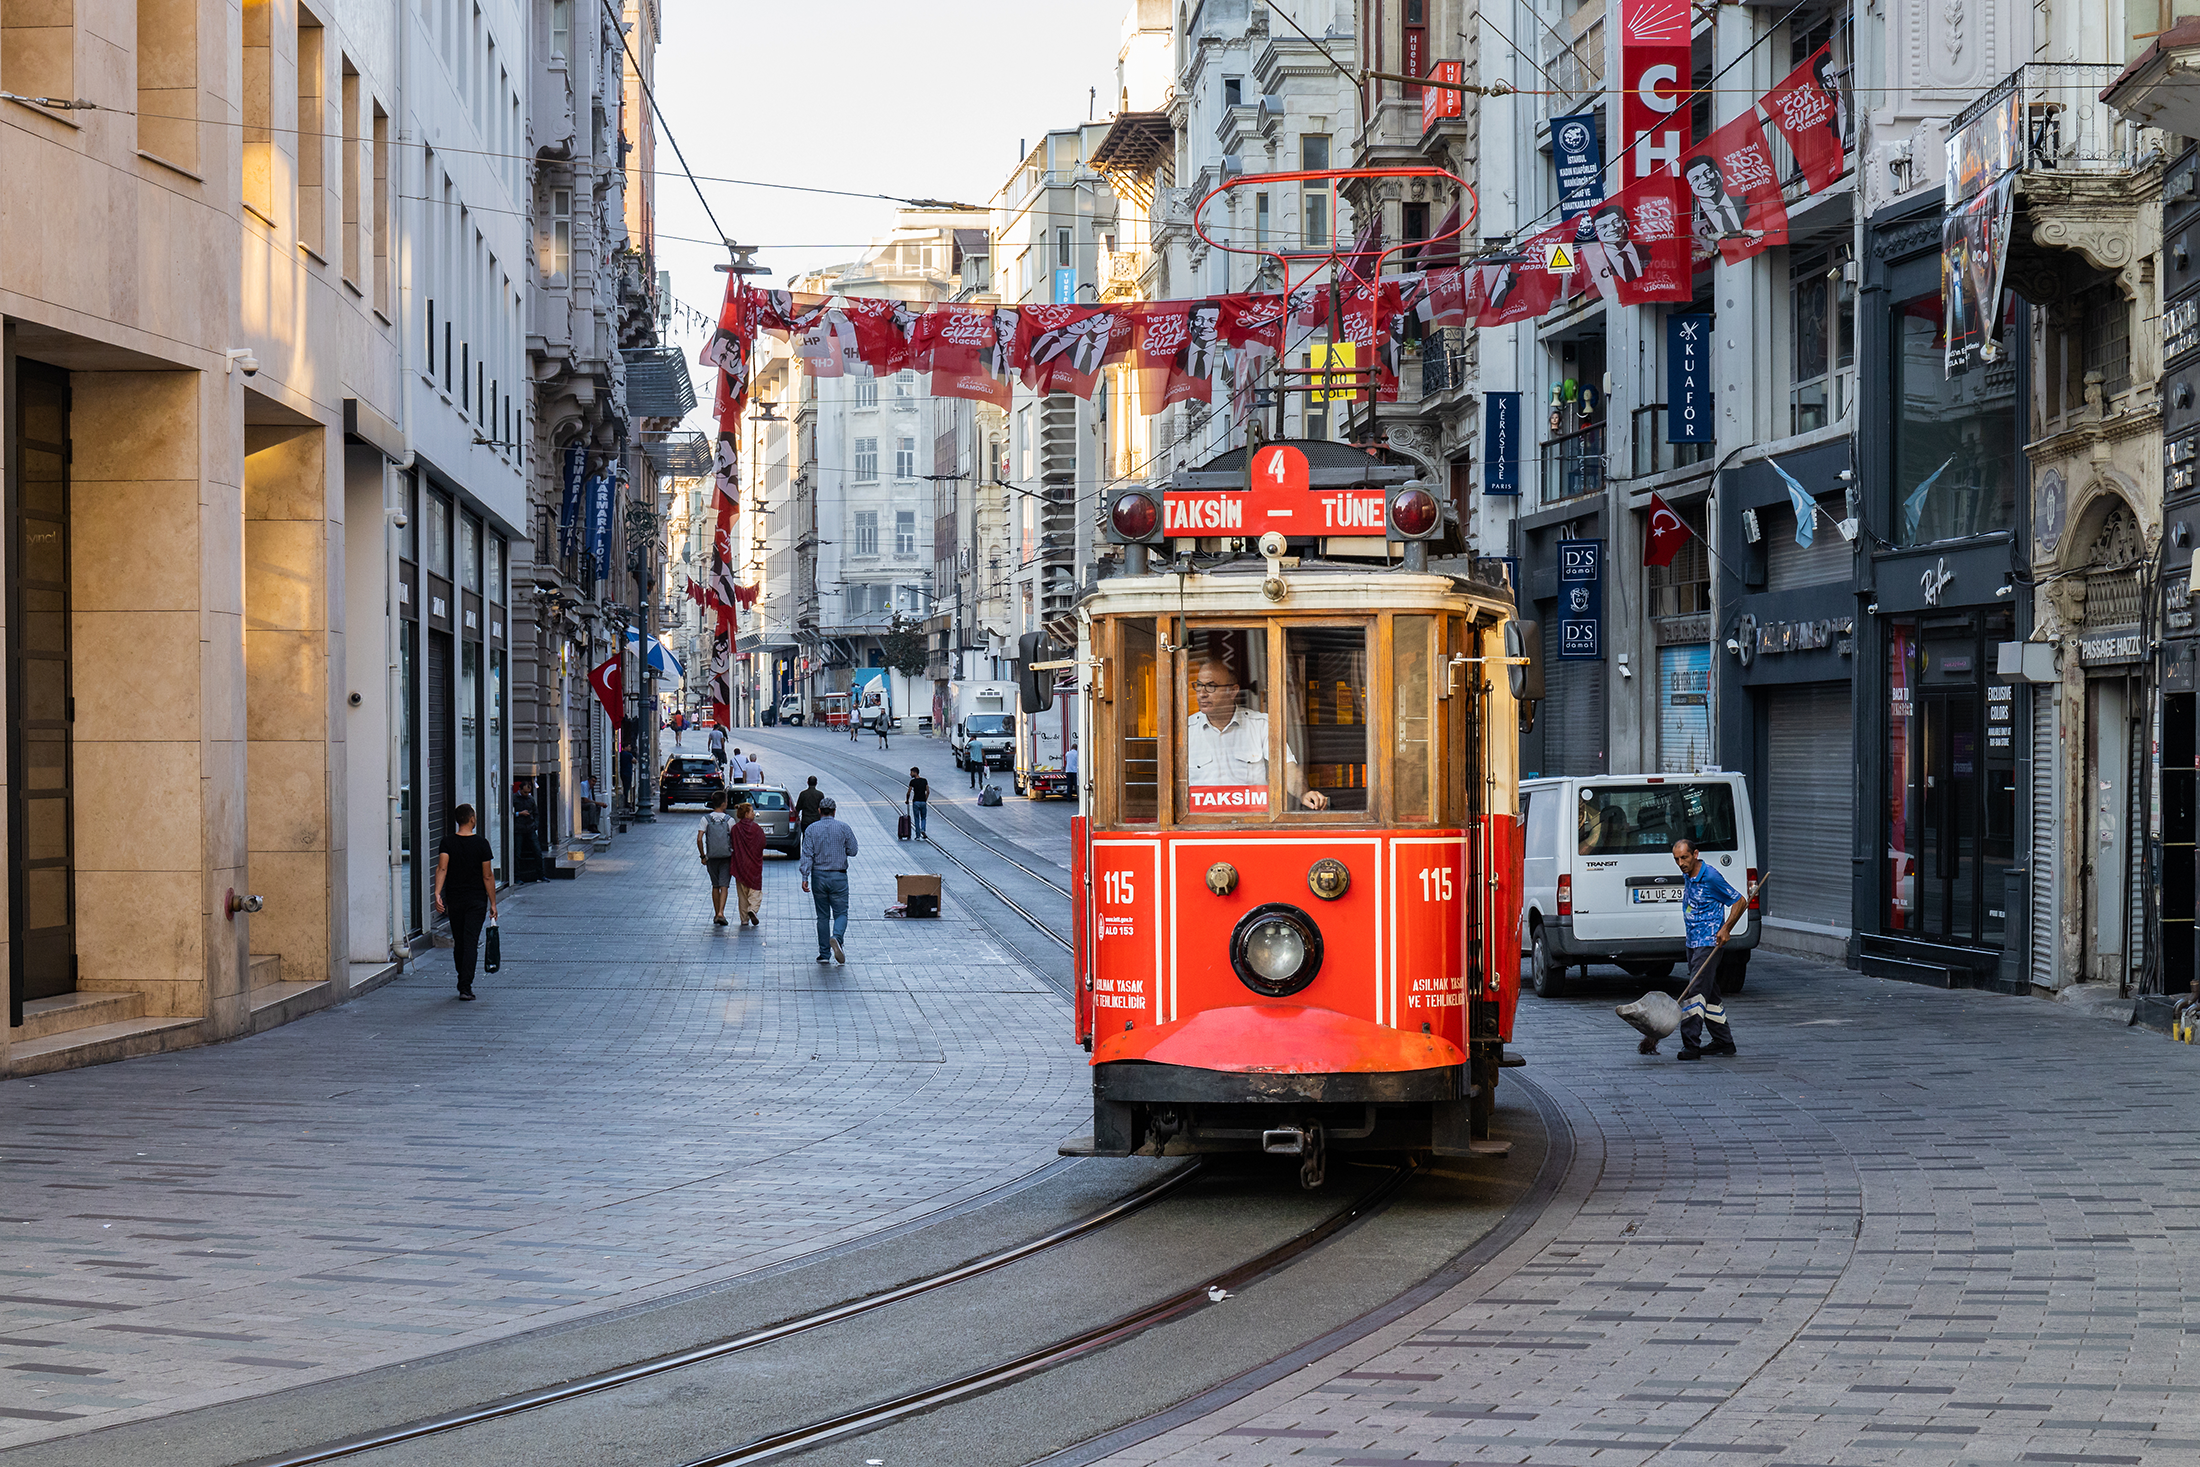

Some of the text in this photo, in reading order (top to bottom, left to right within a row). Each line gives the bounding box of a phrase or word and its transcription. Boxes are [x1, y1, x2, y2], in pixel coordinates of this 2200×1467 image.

[1446, 65, 1454, 113] Huber
[1776, 93, 1793, 107] her
[1784, 89, 1815, 116] ÇOK
[1785, 97, 1830, 130] GÜZEL
[1796, 113, 1827, 132] olacak
[1584, 187, 1591, 196] VE
[949, 305, 966, 314] her
[949, 314, 984, 327] ÇOK
[1147, 315, 1164, 323] her
[941, 323, 992, 338] GÜZEL
[1110, 327, 1131, 337] CHP
[1149, 320, 1182, 338] ÇOK
[948, 337, 982, 346] olacak
[1150, 348, 1178, 356] olaca
[1684, 343, 1695, 436] KUAFÖR
[1498, 398, 1506, 480] KÉRASTASE
[1268, 450, 1285, 483] 4
[596, 476, 609, 534] MARMARA
[1163, 494, 1242, 528] TAKSİM
[1322, 492, 1386, 527] TÜNE
[596, 539, 605, 580] LOKAL
[1566, 551, 1594, 566] D'S
[1566, 625, 1593, 640] D'S
[2082, 638, 2116, 659] PASSAGE
[1988, 686, 2011, 701] EXCLUSIVE
[1991, 705, 2009, 720] COLORS
[1191, 789, 1267, 806] TAKSİM
[1104, 871, 1134, 904] 115
[1419, 867, 1452, 901] 115
[1640, 890, 1650, 899] 41
[1655, 890, 1667, 899] UE
[1105, 926, 1134, 935] ALO 153
[1116, 980, 1143, 993] YASAK
[1412, 978, 1448, 992] ASILMAK
[1100, 994, 1146, 1010] TEHLİKELİDİR
[1408, 995, 1421, 1008] VE
